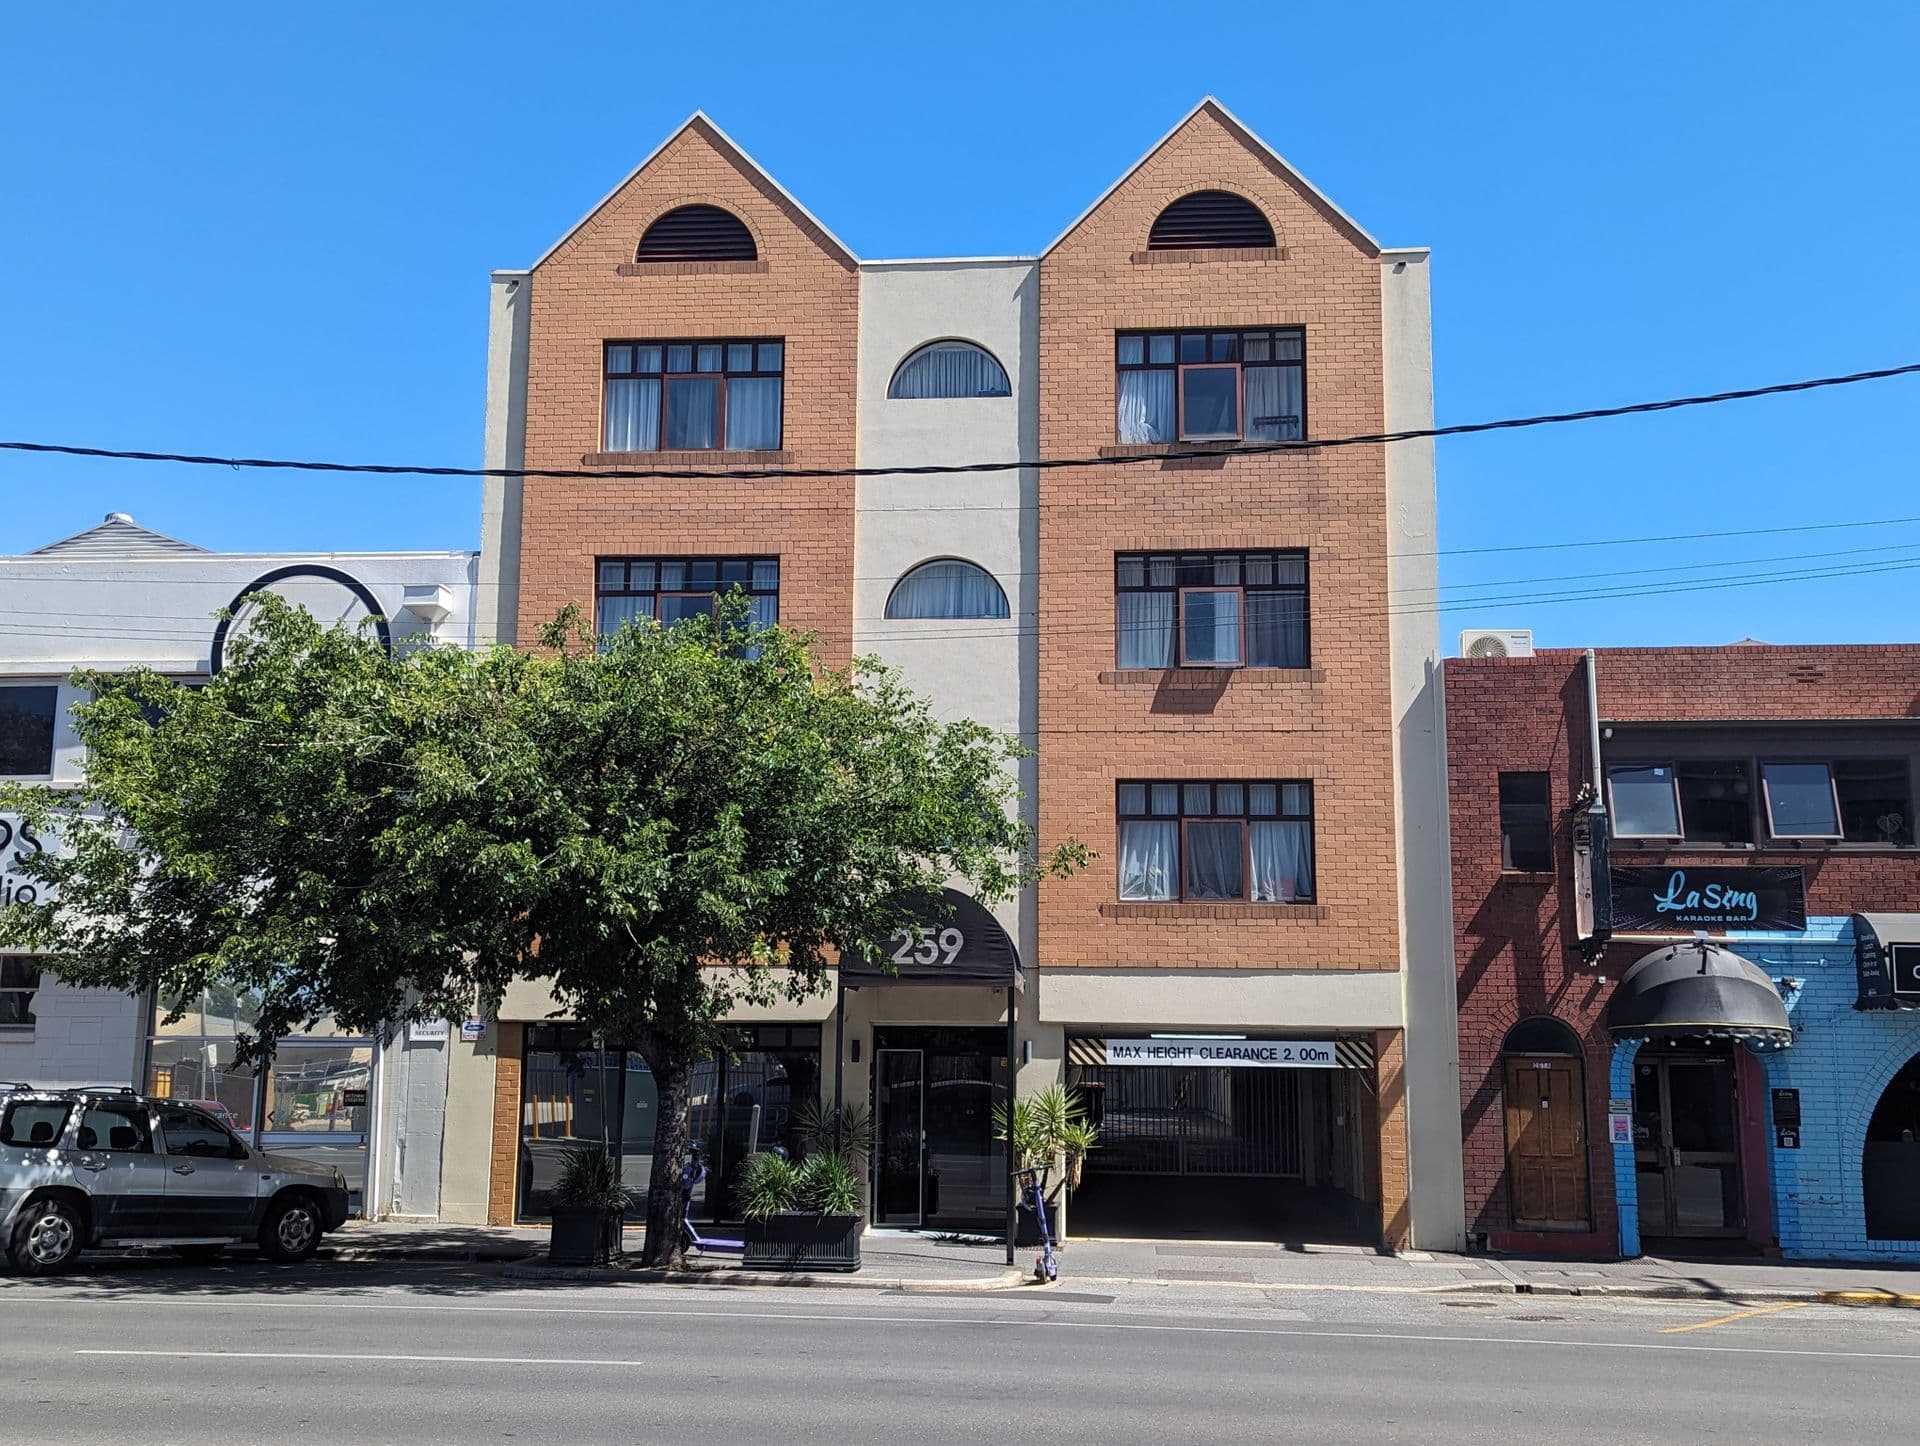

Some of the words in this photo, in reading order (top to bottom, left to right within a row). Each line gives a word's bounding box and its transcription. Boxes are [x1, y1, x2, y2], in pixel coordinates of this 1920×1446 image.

[1653, 870, 1700, 913] La
[890, 926, 964, 965] 259
[1112, 1046, 1141, 1058] MAX
[1147, 1047, 1194, 1059] HEIGHT
[1199, 1047, 1277, 1060] CLEARANCE
